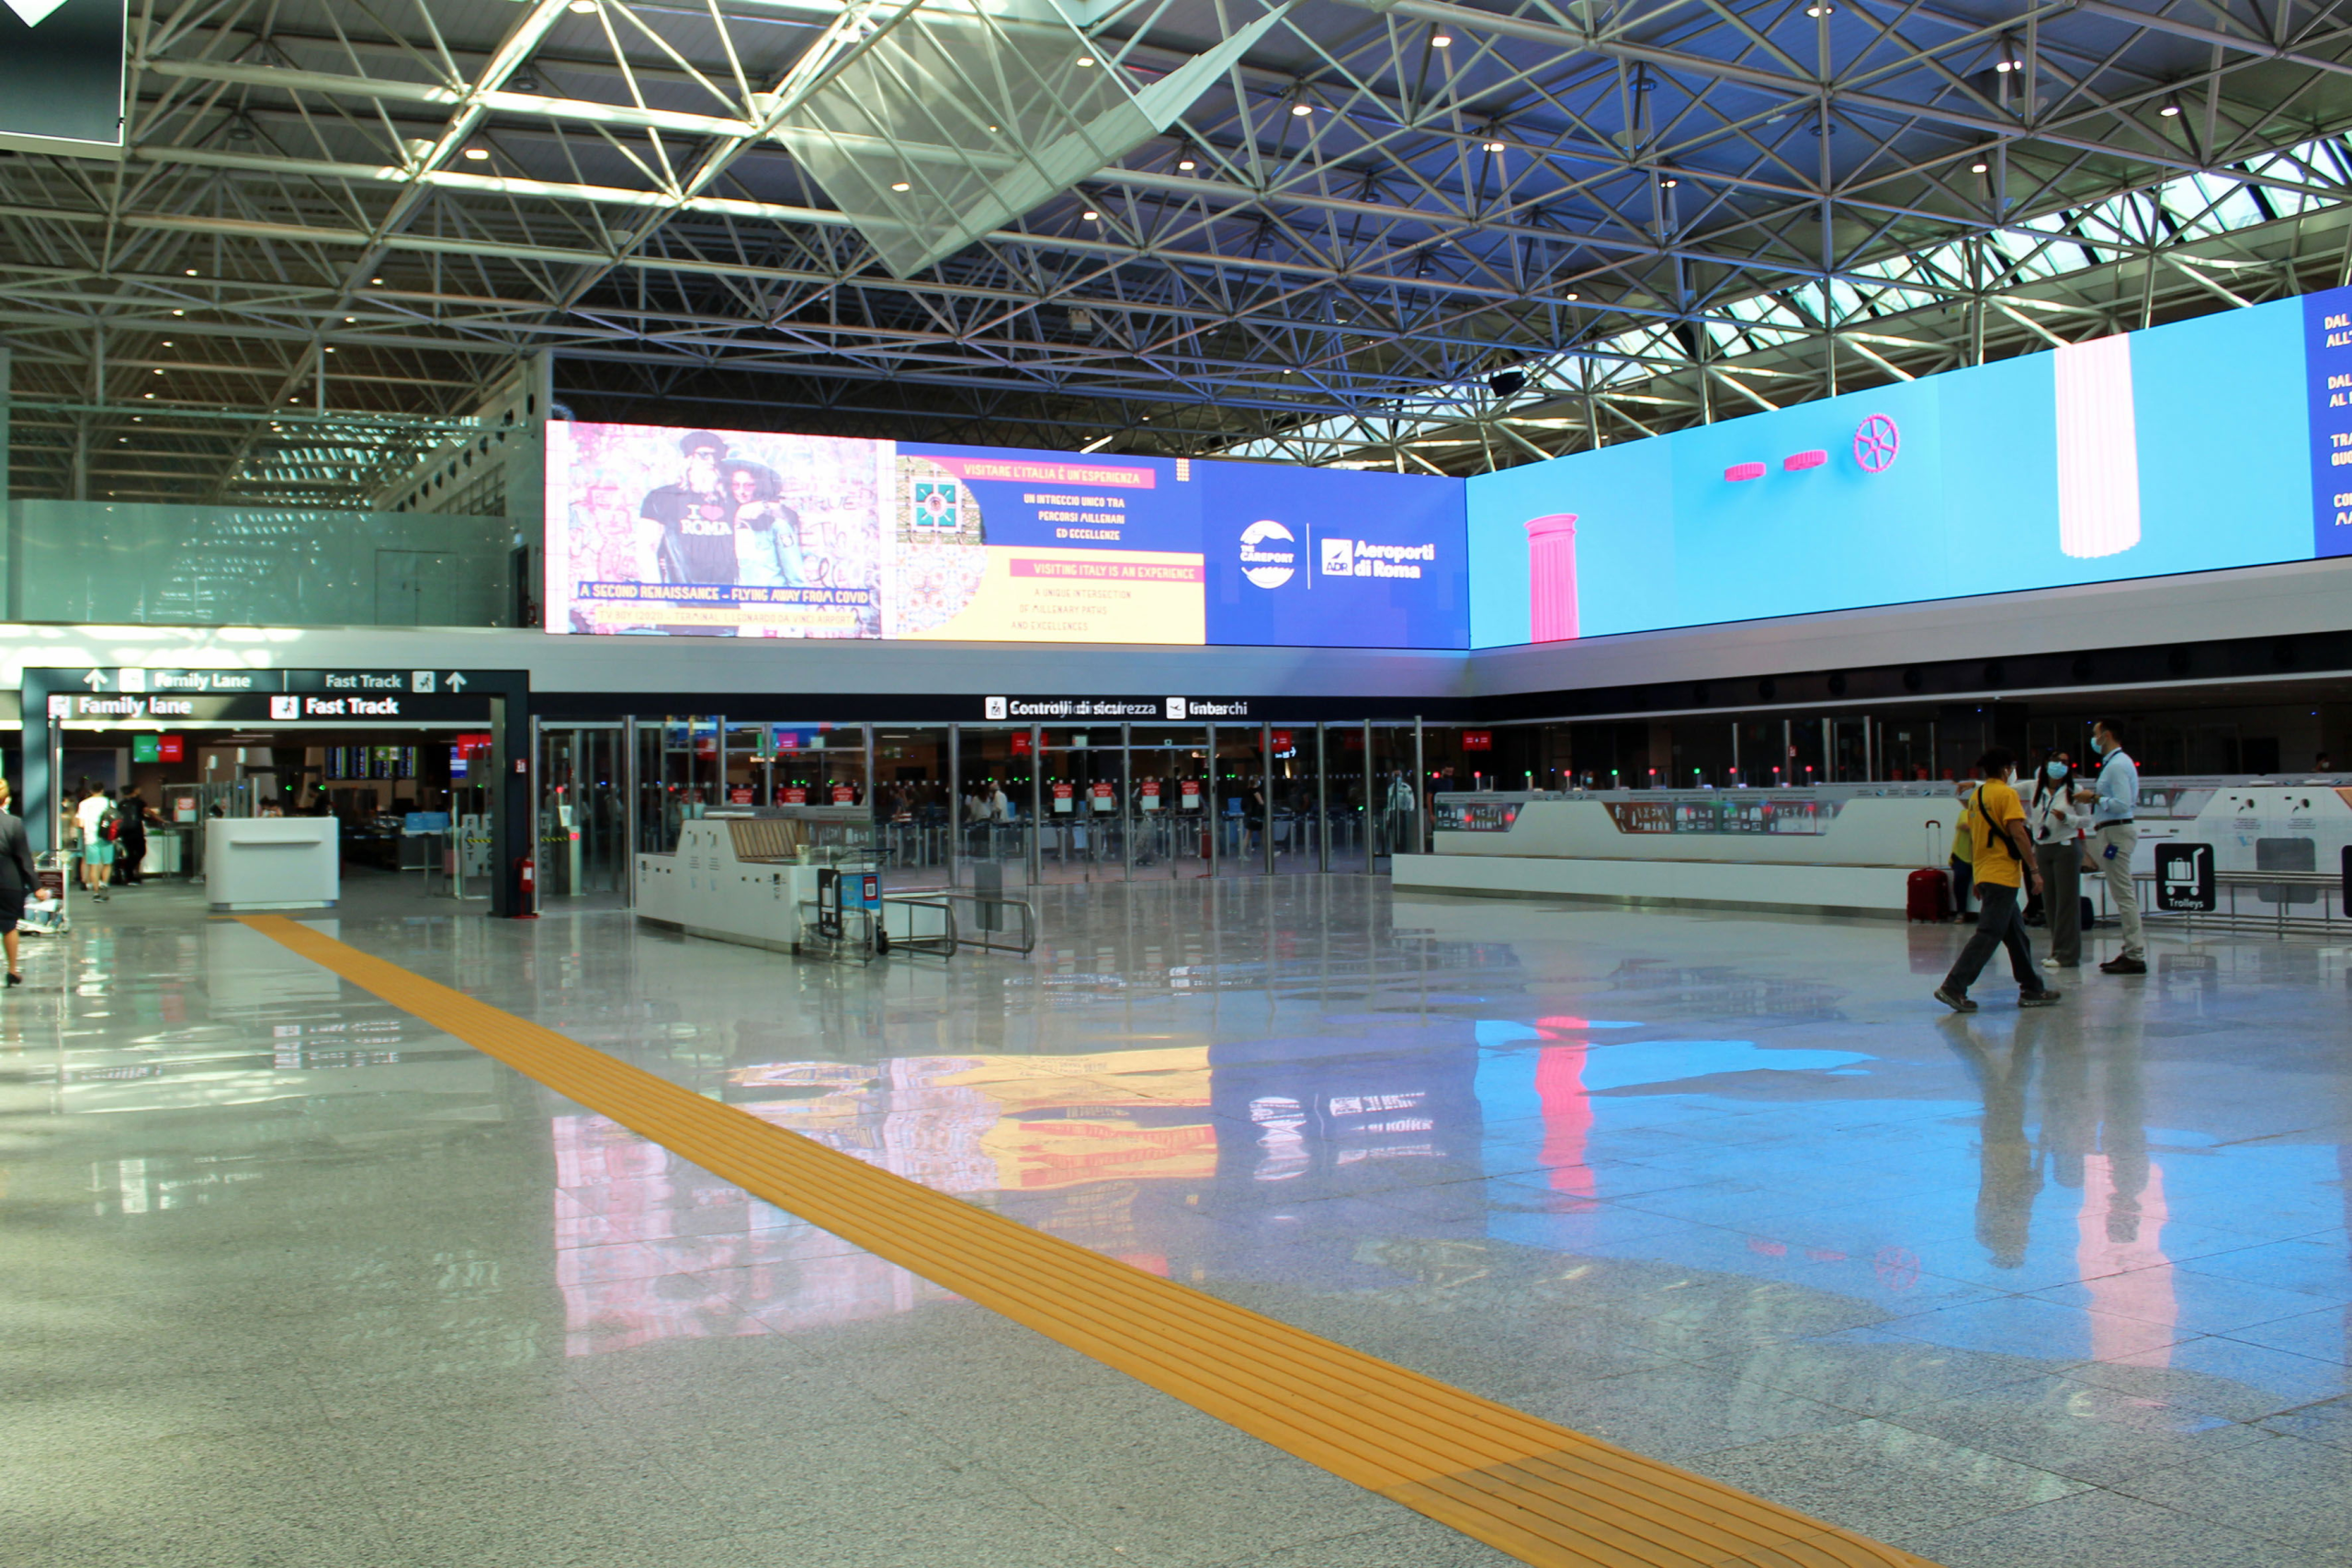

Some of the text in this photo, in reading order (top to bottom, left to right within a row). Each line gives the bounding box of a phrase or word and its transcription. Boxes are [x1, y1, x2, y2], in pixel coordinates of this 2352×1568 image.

[2324, 313, 2351, 330] DAL
[2329, 392, 2347, 408] AL
[964, 464, 1140, 484] VISITARE L'ITALIA È UN'ESPERIENZA
[1023, 493, 1125, 508] UN INTRECCIO UNICO TRA
[686, 504, 701, 519] I
[1038, 511, 1125, 525] PERCORSI MILLENARI
[680, 519, 732, 536] ROMA
[1057, 528, 1121, 540] ED ECCELLENZE
[1239, 552, 1295, 563] CAREPORT
[1354, 540, 1435, 563] Aeroporti
[1034, 563, 1195, 580] VISITING ITALY IS AN EXPERIENCE
[1326, 562, 1349, 572] ADR
[1354, 559, 1421, 579] di Roma
[580, 584, 590, 597] A
[593, 585, 638, 598] SECOND
[640, 585, 719, 601] RENAISSANCE
[731, 588, 768, 602] FLYING
[771, 590, 801, 603] AWAY
[802, 591, 833, 604] FROM
[835, 591, 868, 604] COVID
[1043, 589, 1070, 597] UNIQUE
[1073, 590, 1132, 599] INTERSECTION
[1020, 604, 1107, 615] OF MILLENARY PATHS
[600, 610, 612, 620] TV
[615, 611, 632, 621] BOY
[675, 613, 719, 623] TERMINAL
[731, 614, 775, 624] LEONARDO
[778, 615, 789, 624] DA
[794, 615, 816, 625] VINCI
[818, 615, 852, 625] AIRPORT
[1012, 621, 1089, 631] AND EXCELLENCES
[154, 671, 252, 692] Family Lane
[325, 673, 401, 688] Fast Track
[79, 696, 193, 718] Family lane
[306, 697, 400, 715] Fast Track
[2168, 897, 2204, 909] Trolleys
